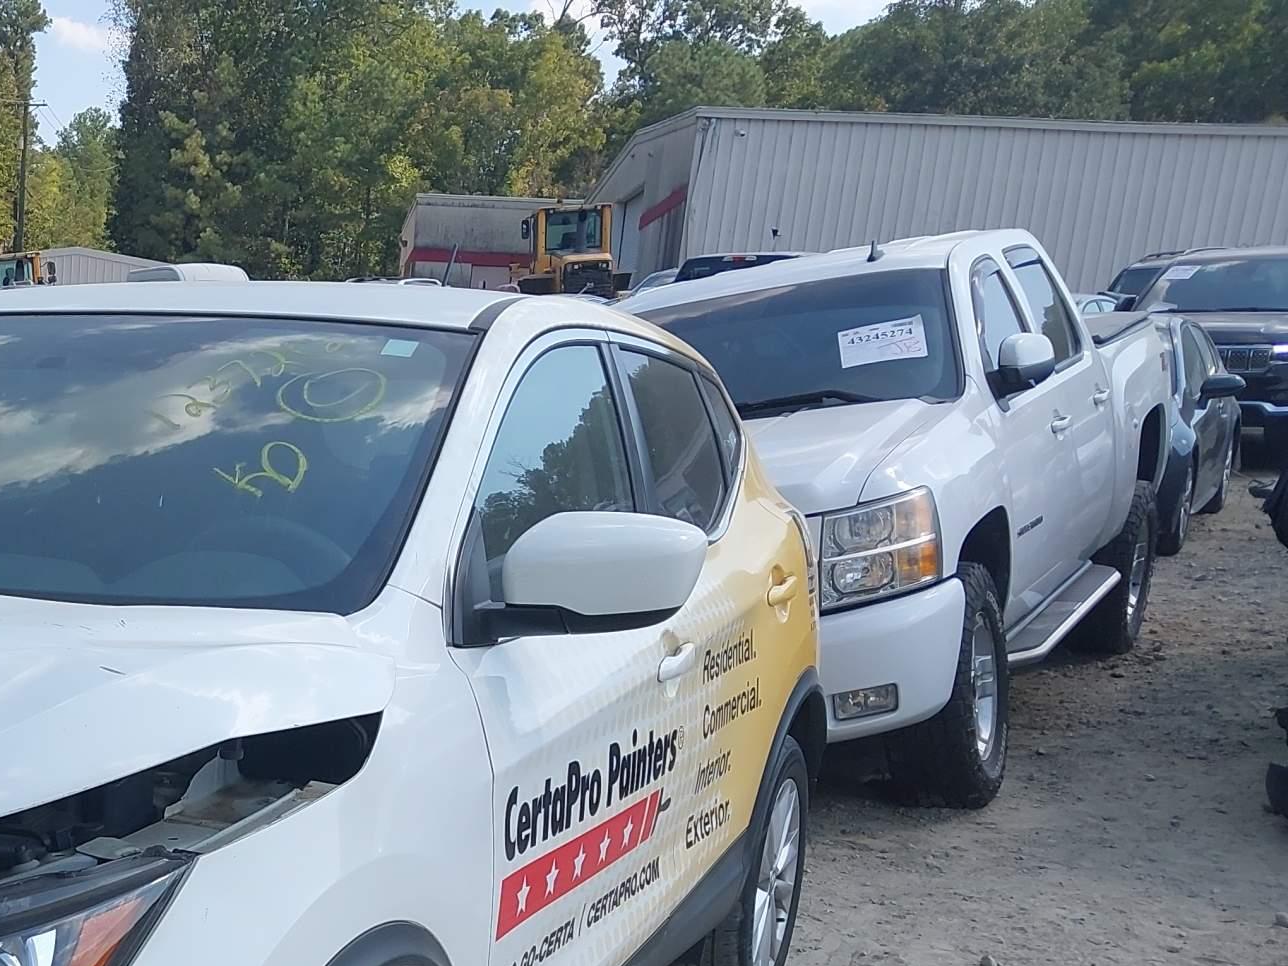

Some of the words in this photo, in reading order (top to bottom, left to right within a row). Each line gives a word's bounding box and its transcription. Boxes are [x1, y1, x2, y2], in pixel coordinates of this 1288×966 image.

[847, 327, 913, 345] 43245274
[702, 628, 758, 685] Residential.
[702, 677, 763, 740] Commercial.
[695, 748, 732, 795] Interior.
[503, 760, 602, 862] CertaPro
[685, 798, 731, 850] Exterior.
[586, 856, 661, 928] CERTAPRO.COM
